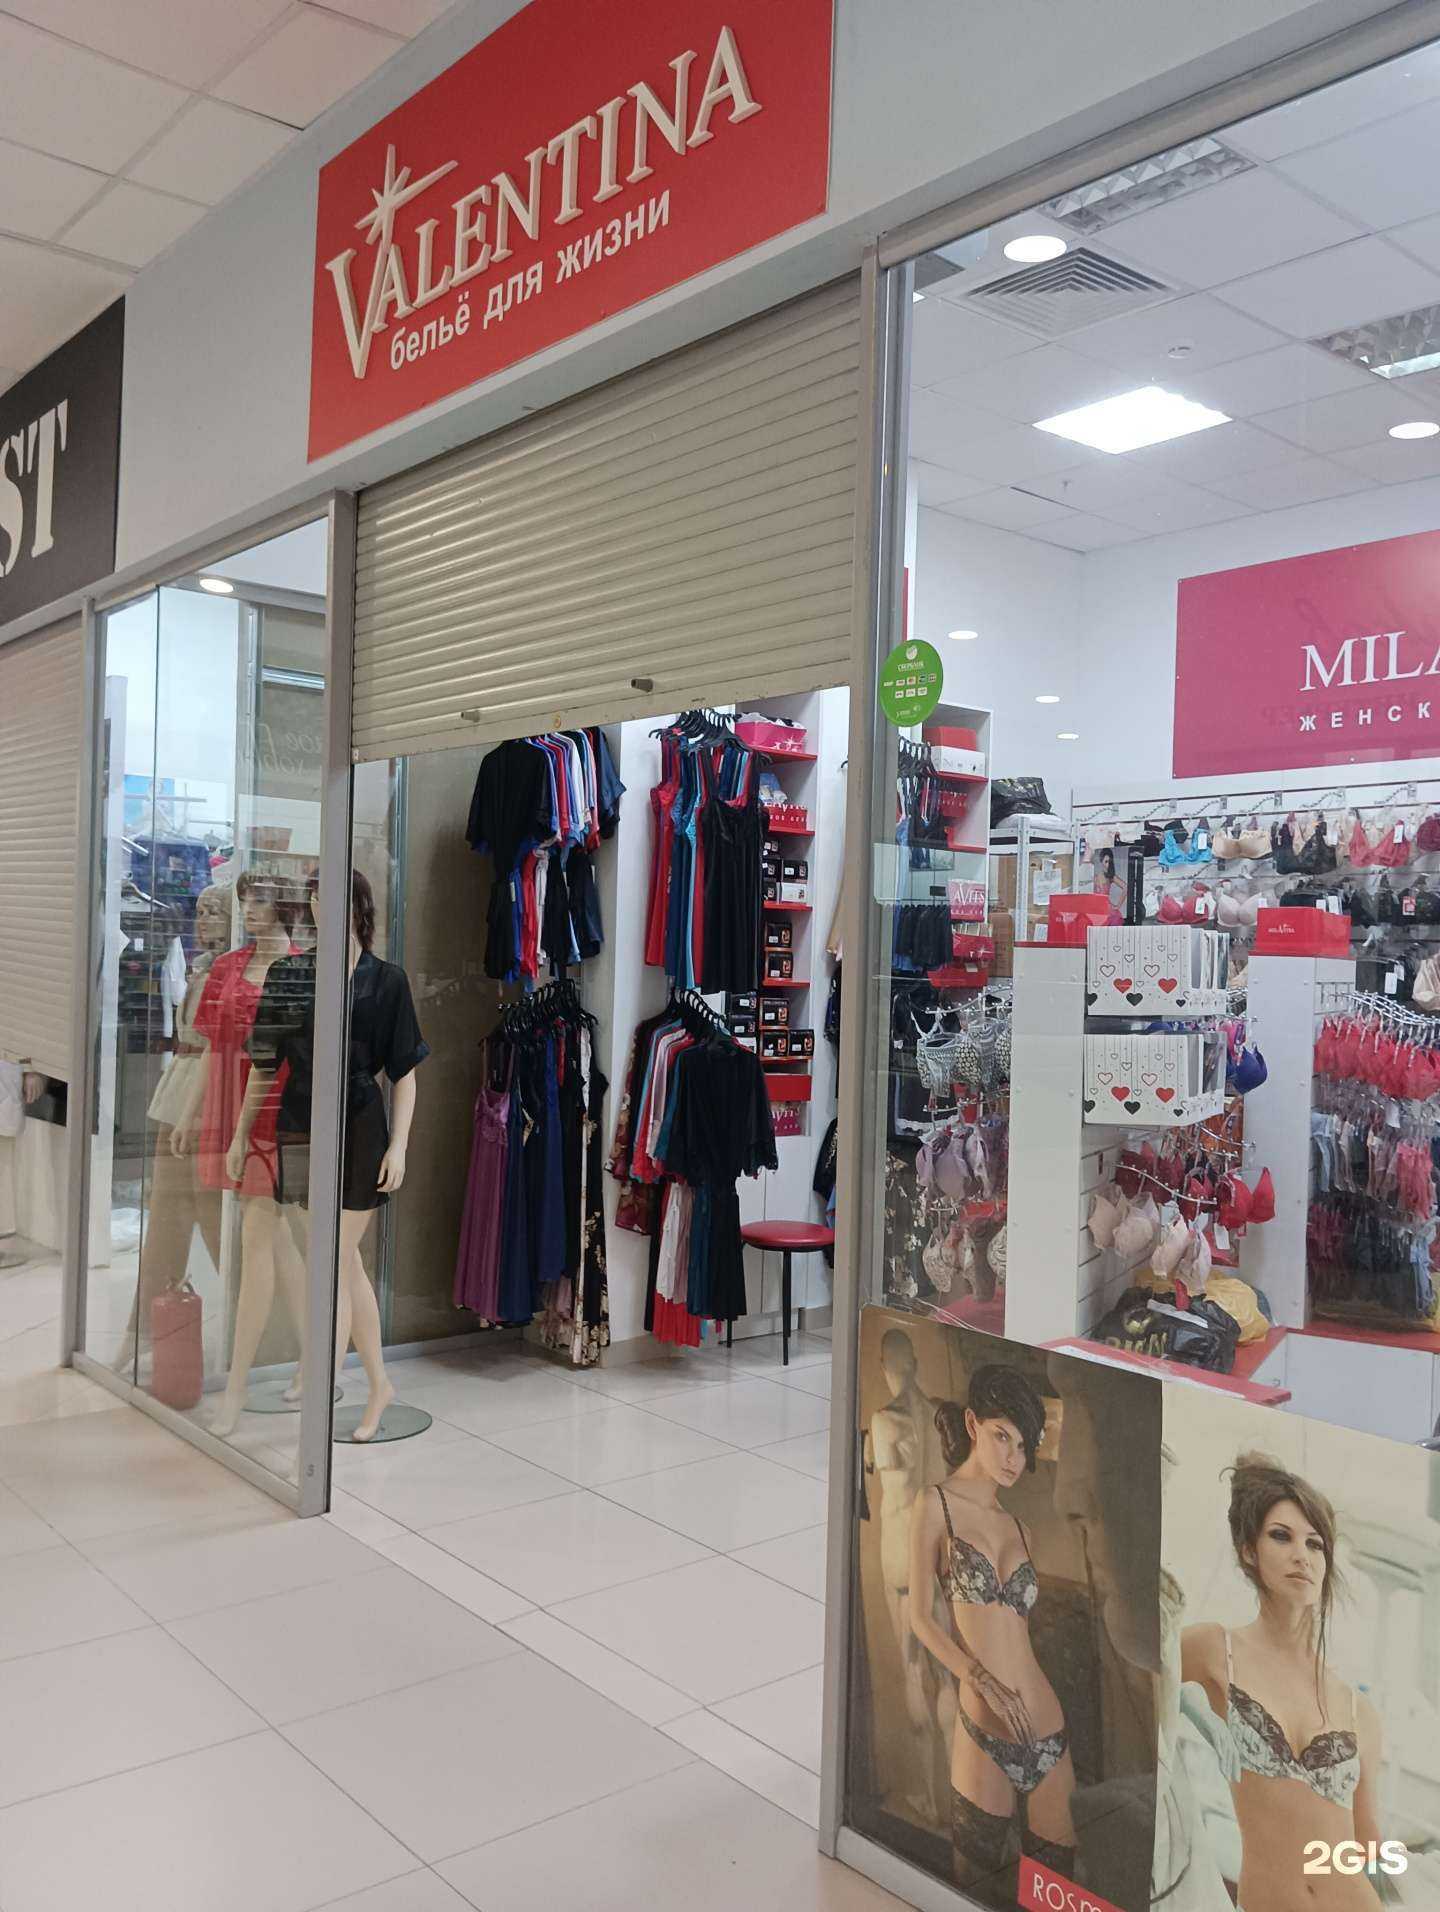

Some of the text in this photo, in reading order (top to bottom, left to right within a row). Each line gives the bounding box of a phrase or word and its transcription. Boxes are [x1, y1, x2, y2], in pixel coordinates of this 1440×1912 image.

[325, 25, 762, 379] VALENTINA
[390, 190, 670, 370] бельё для жизни
[1300, 702, 1431, 731] ЖЕНСК
